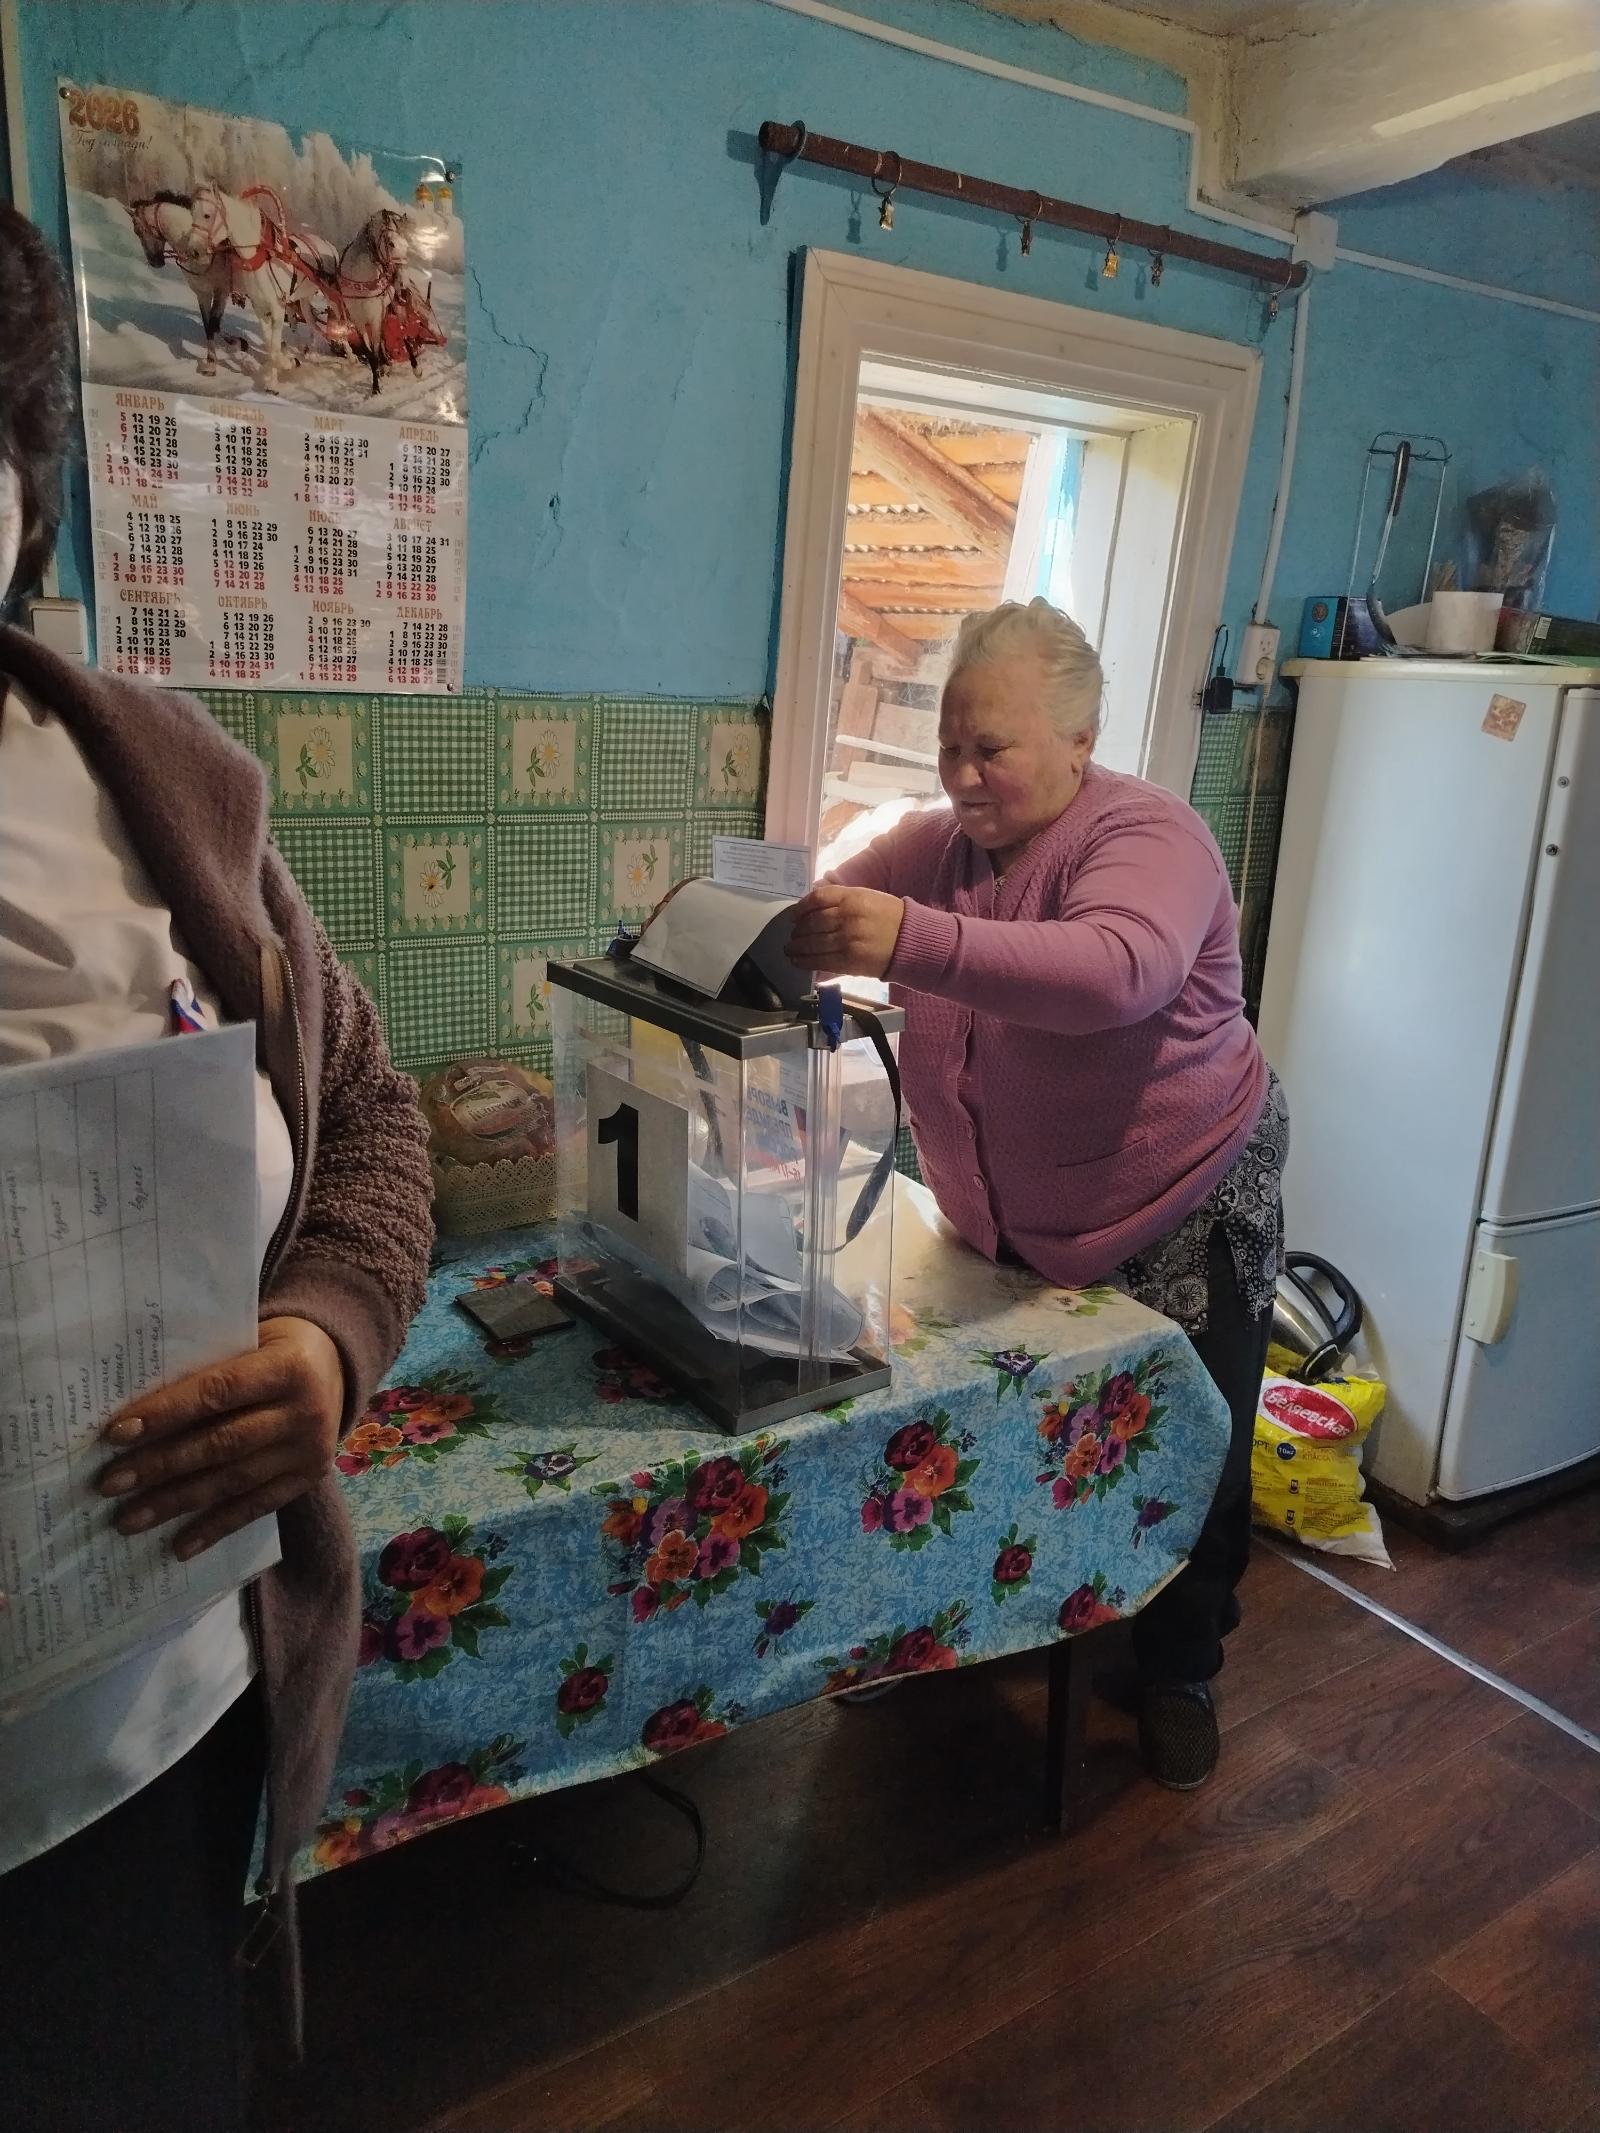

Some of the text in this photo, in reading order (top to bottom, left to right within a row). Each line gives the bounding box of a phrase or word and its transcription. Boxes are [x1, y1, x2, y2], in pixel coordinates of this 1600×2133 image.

[68, 88, 140, 137] 2026
[115, 393, 165, 411] ЯНВАРЬ
[131, 413, 144, 423] 12
[148, 414, 160, 425] 19
[165, 416, 177, 427] 26
[313, 416, 345, 432] МАРТ
[132, 424, 144, 434] 13
[148, 425, 161, 436] 20
[165, 427, 177, 437] 27
[399, 426, 439, 443] АПРЕЛЬ
[133, 435, 145, 445] 14
[149, 436, 161, 447] 21
[166, 438, 178, 448] 28
[225, 434, 237, 444] 10
[241, 436, 252, 446] 17
[256, 437, 268, 447] 24
[225, 444, 236, 454] 11
[241, 446, 252, 456] 18
[256, 447, 268, 457] 25
[225, 455, 237, 465] 12
[241, 456, 253, 466] 19
[256, 458, 268, 468] 26
[314, 454, 324, 463] 11
[329, 455, 340, 465] 18
[344, 457, 354, 467] 25
[440, 467, 450, 477] 29
[314, 474, 325, 484] 13
[328, 475, 340, 485] 20
[343, 477, 354, 486] 27
[412, 475, 423, 484] 16
[426, 476, 436, 485] 23
[439, 477, 450, 487] 30
[131, 493, 158, 509] МАЙ
[226, 502, 260, 517] ИЮНЬ
[138, 512, 149, 522] 11
[153, 514, 165, 523] 18
[169, 514, 181, 524] 25
[237, 520, 248, 530] 15
[252, 521, 263, 531] 22
[266, 522, 278, 532] 29
[140, 544, 152, 554] 14
[155, 544, 166, 554] 21
[171, 546, 183, 556] 28
[223, 549, 233, 559] 11
[238, 550, 249, 560] 18
[253, 551, 264, 561] 25
[140, 554, 152, 564] 15
[156, 555, 167, 564] 22
[172, 556, 184, 566] 29
[318, 556, 329, 566] 16
[332, 557, 343, 567] 23
[347, 558, 358, 568] 30
[304, 565, 314, 574] 10
[318, 566, 329, 575] 17
[332, 567, 344, 576] 24
[347, 568, 357, 577] 31
[396, 572, 408, 581] 14
[411, 573, 421, 582] 21
[425, 574, 436, 583] 28
[396, 581, 407, 590] 15
[410, 582, 422, 592] 22
[425, 583, 436, 592] 29
[120, 588, 182, 605] СЕНТЯБРЬ
[218, 595, 268, 610] ОКТЯБРЬ
[312, 600, 354, 615] НОЯБРЬ
[396, 606, 443, 620] ДЕКАБРЬ
[142, 617, 154, 626] 15
[158, 618, 170, 627] 22
[174, 619, 186, 628] 29
[234, 612, 244, 622] 12
[248, 613, 259, 622] 19
[263, 614, 274, 623] 26
[332, 618, 343, 626] 16
[346, 618, 357, 627] 23
[360, 619, 371, 628] 30
[143, 627, 154, 636] 16
[158, 628, 170, 637] 23
[174, 629, 186, 638] 30
[234, 622, 244, 631] 13
[248, 622, 260, 632] 20
[263, 623, 274, 632] 27
[318, 626, 328, 635] 10
[332, 627, 343, 636] 17
[346, 627, 357, 637] 24
[412, 631, 422, 640] 15
[425, 632, 434, 641] 22
[438, 632, 448, 641] 29
[234, 641, 245, 650] 15
[249, 642, 260, 651] 22
[263, 642, 274, 651] 29
[412, 640, 422, 649] 16
[424, 641, 434, 649] 23
[438, 642, 448, 650] 30
[318, 654, 329, 663] 13
[332, 655, 343, 663] 20
[346, 656, 356, 664] 27
[598, 1102, 638, 1224] 1
[1265, 1391, 1350, 1438] Беляевская
